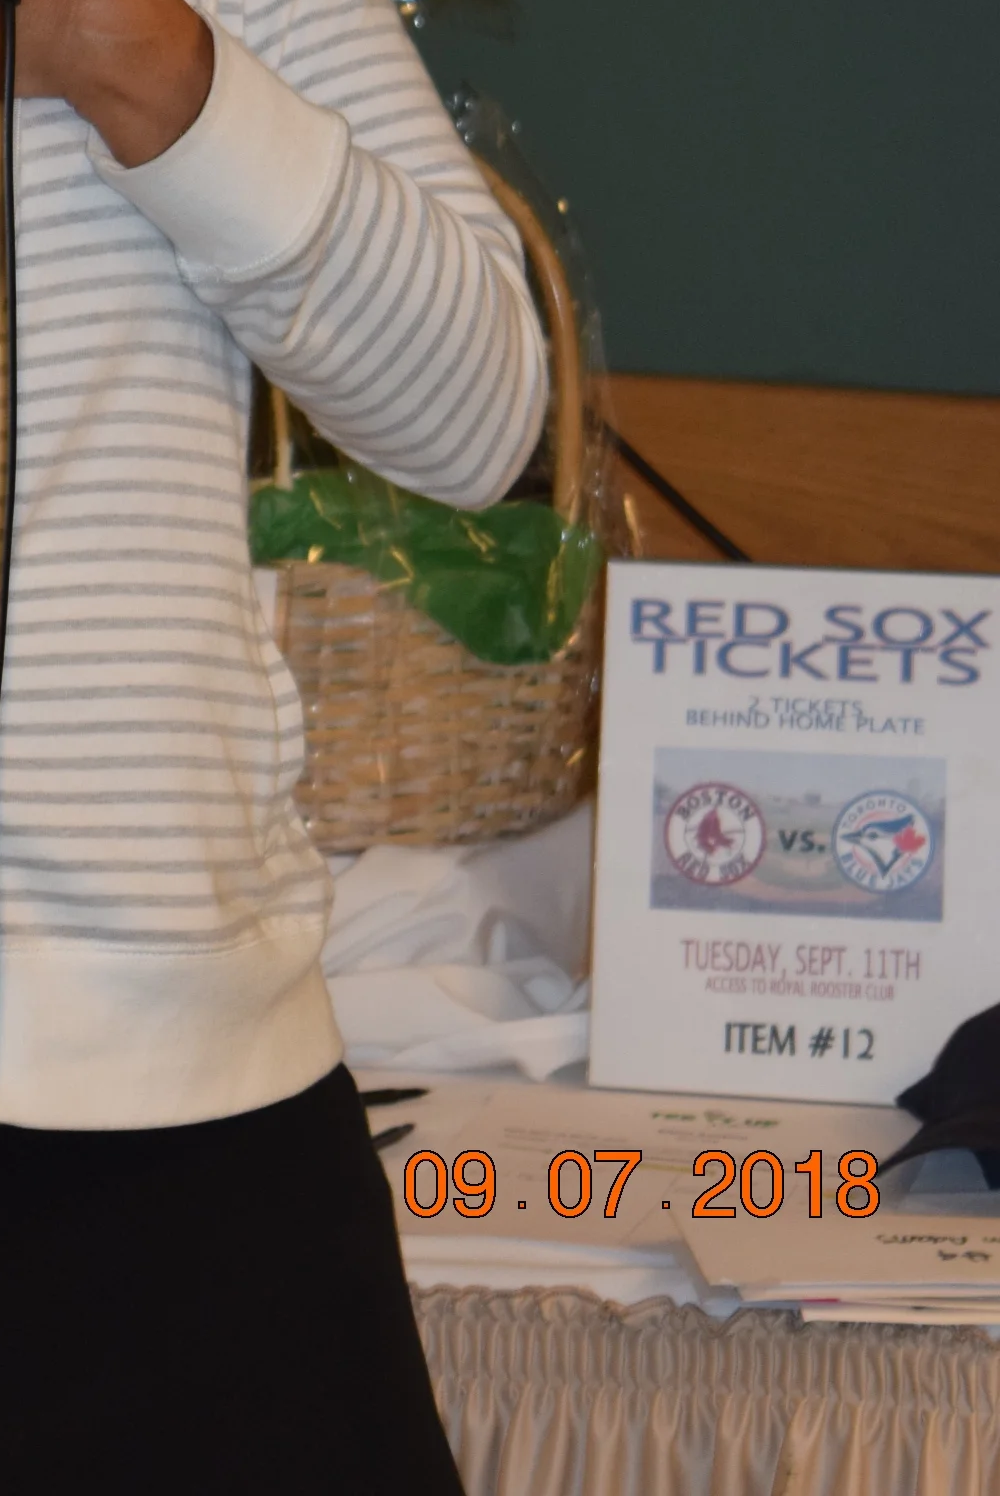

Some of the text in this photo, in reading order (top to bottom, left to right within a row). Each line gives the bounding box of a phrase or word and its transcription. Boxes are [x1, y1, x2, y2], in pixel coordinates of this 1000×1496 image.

[629, 596, 993, 649] RED SOX
[630, 635, 982, 687] TICKETS
[685, 708, 926, 736] BEHIND HOME PLATE
[769, 696, 864, 718] TICKETS
[674, 789, 755, 822] BOSTON
[680, 938, 923, 981] TUESDAY, SEPT. 11TH
[704, 976, 895, 1001] ACCESS TO ROYAL ROOSTER CLUB
[723, 1021, 876, 1061] ITEM #12
